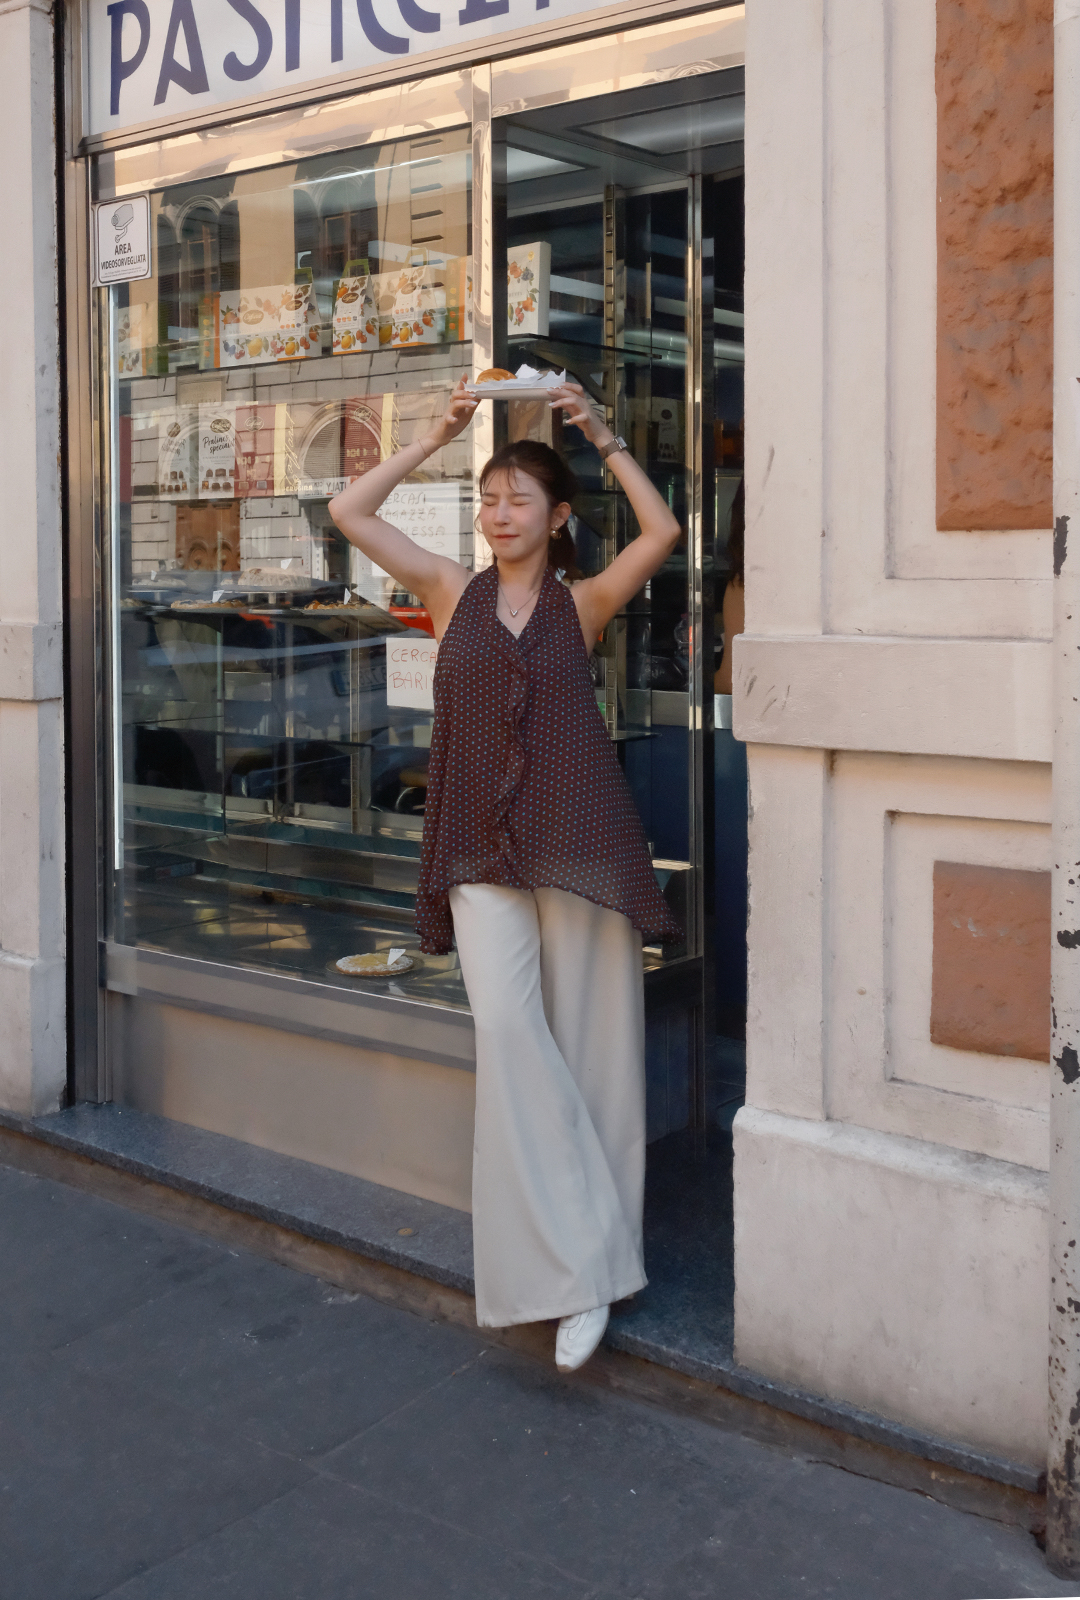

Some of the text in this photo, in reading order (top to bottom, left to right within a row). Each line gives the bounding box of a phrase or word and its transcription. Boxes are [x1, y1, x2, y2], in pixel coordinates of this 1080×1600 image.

[114, 243, 132, 256] AREA
[101, 254, 147, 270] VIDEOSORVEGLIATA
[382, 492, 426, 505] ERCASI
